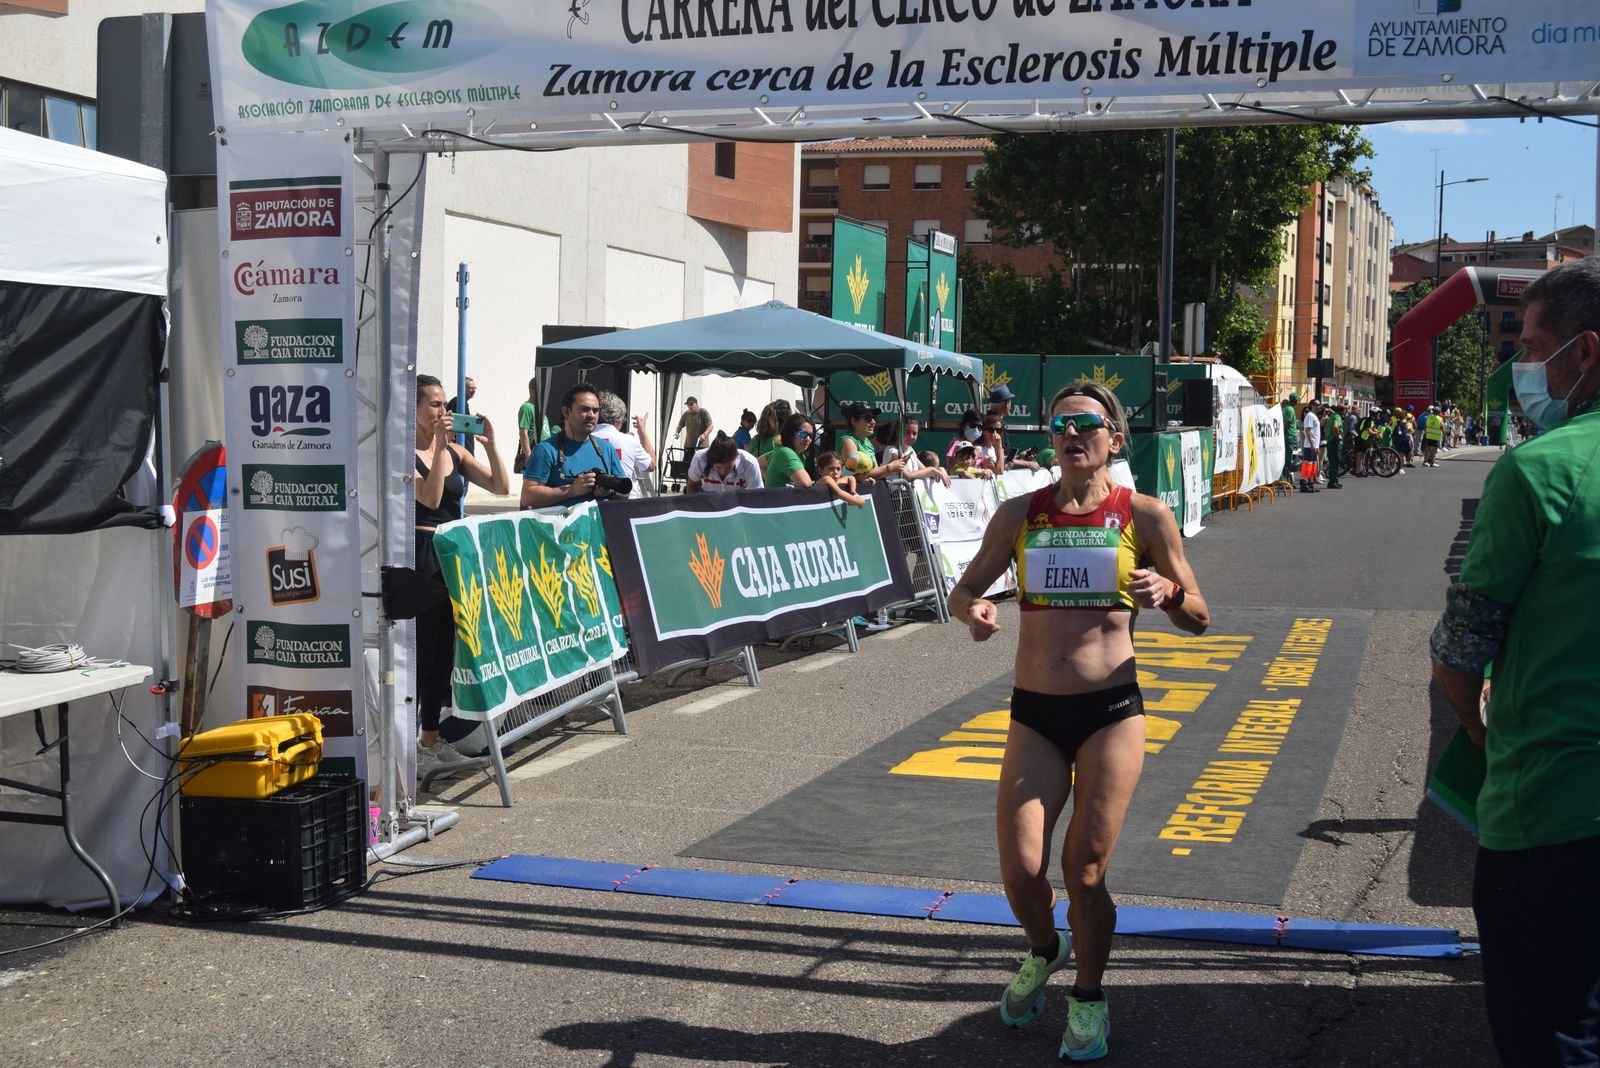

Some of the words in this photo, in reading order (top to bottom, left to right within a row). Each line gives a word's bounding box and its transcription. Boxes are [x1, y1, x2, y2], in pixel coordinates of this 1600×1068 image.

[1369, 17, 1507, 37] AYUNTAMIENTO
[1532, 22, 1567, 44] dia
[1574, 25, 1600, 43] m
[1368, 38, 1396, 57] DE
[1402, 35, 1506, 57] ZAMORA
[543, 63, 696, 97] Zamora
[706, 66, 815, 91] cerca
[826, 52, 874, 90] de
[886, 50, 925, 88] la
[936, 38, 1142, 86] Esclerosis
[1155, 29, 1337, 82] Múltiple
[238, 99, 303, 119] ASOCIACIÓN
[308, 95, 370, 113] ZAMORANA
[375, 93, 392, 109] DE
[397, 89, 462, 107] ESCLEROSIS
[467, 85, 521, 102] MÚLTIPLE
[255, 198, 316, 211] DIPUTACIÓN
[319, 198, 334, 208] DE
[254, 211, 336, 230] ZAMORA
[273, 294, 303, 304] Zamora
[270, 335, 336, 349] FUNDACION
[271, 348, 292, 359] CAJA
[293, 347, 336, 358] RURAL
[250, 385, 331, 437] gaza
[252, 440, 286, 451] Ganaderos
[287, 440, 295, 450] de
[297, 440, 331, 450] Zamora
[274, 482, 338, 495] FUNDACION
[274, 495, 294, 506] CAJA
[296, 495, 339, 506] RURAL
[1053, 530, 1107, 539] FUNDACION
[1053, 538, 1074, 546] CAJA
[1076, 538, 1107, 546] RURAL
[1048, 554, 1056, 565] 11
[731, 545, 791, 599] CAJA
[785, 535, 860, 589] RURAL
[272, 561, 312, 591] Susi
[1045, 567, 1090, 589] ELENA
[1078, 599, 1114, 607] RURAL
[276, 638, 343, 652] FUNDACION
[276, 650, 297, 663] CAJA
[300, 652, 344, 663] RURAL
[1217, 698, 1302, 755] INTEGRAL
[1158, 760, 1273, 843] REFORMA
